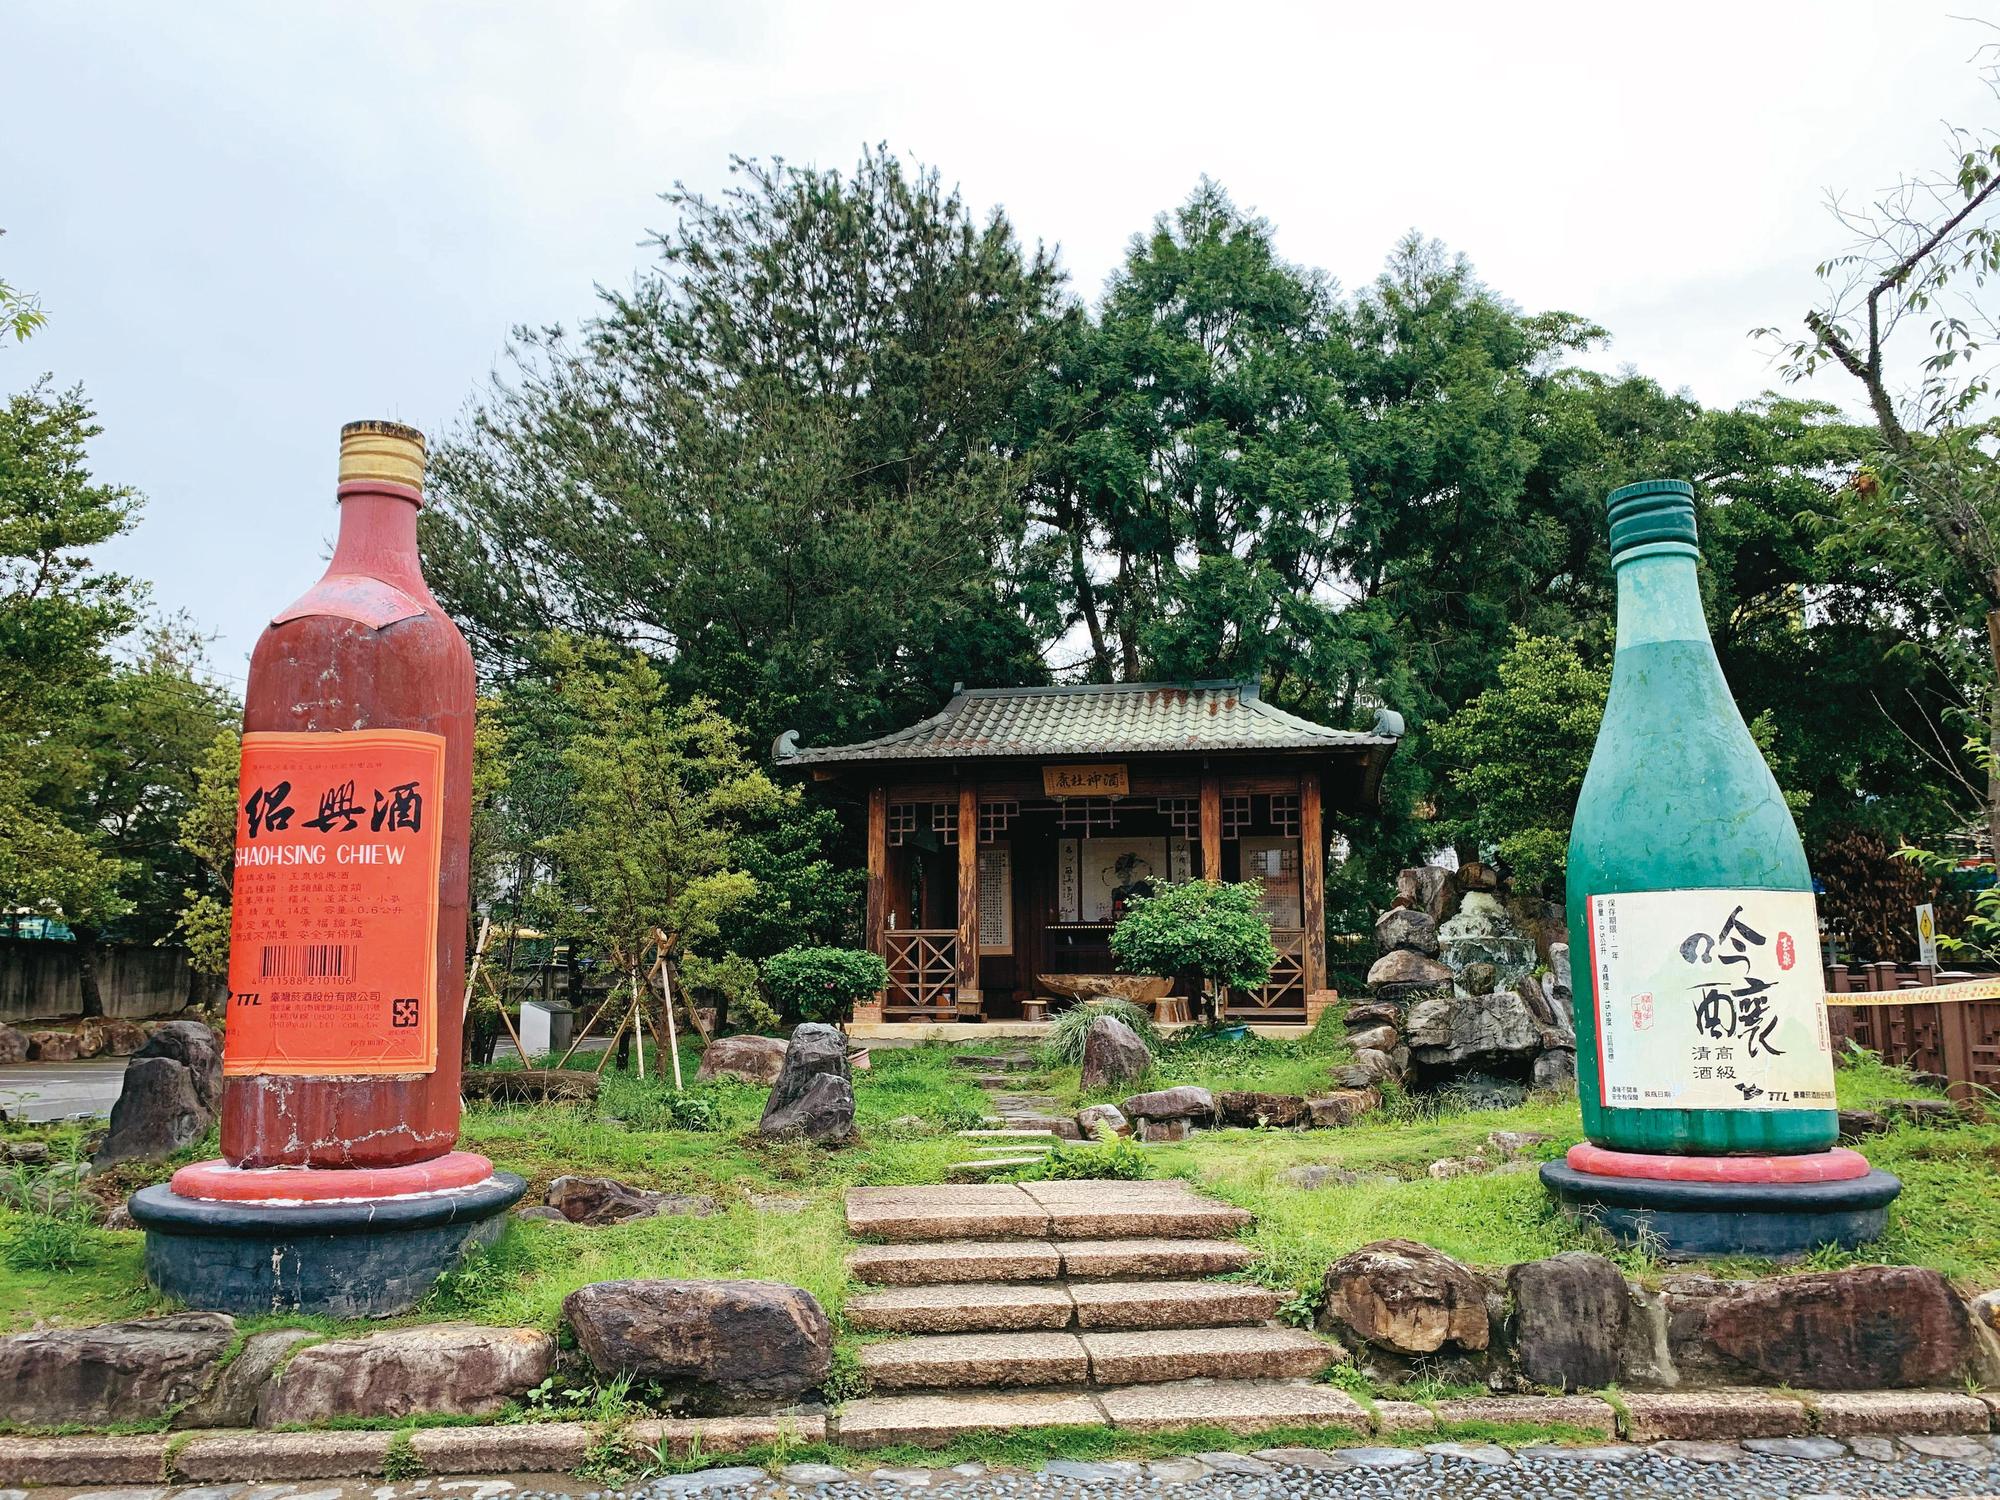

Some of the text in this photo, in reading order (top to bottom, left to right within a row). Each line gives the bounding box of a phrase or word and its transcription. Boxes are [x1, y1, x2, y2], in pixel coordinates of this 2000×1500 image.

[245, 779, 422, 838] 紹興酒
[234, 844, 406, 867] SHAOHSING CHIEW
[237, 993, 262, 1005] TTL
[1768, 1091, 1789, 1101] TTL
